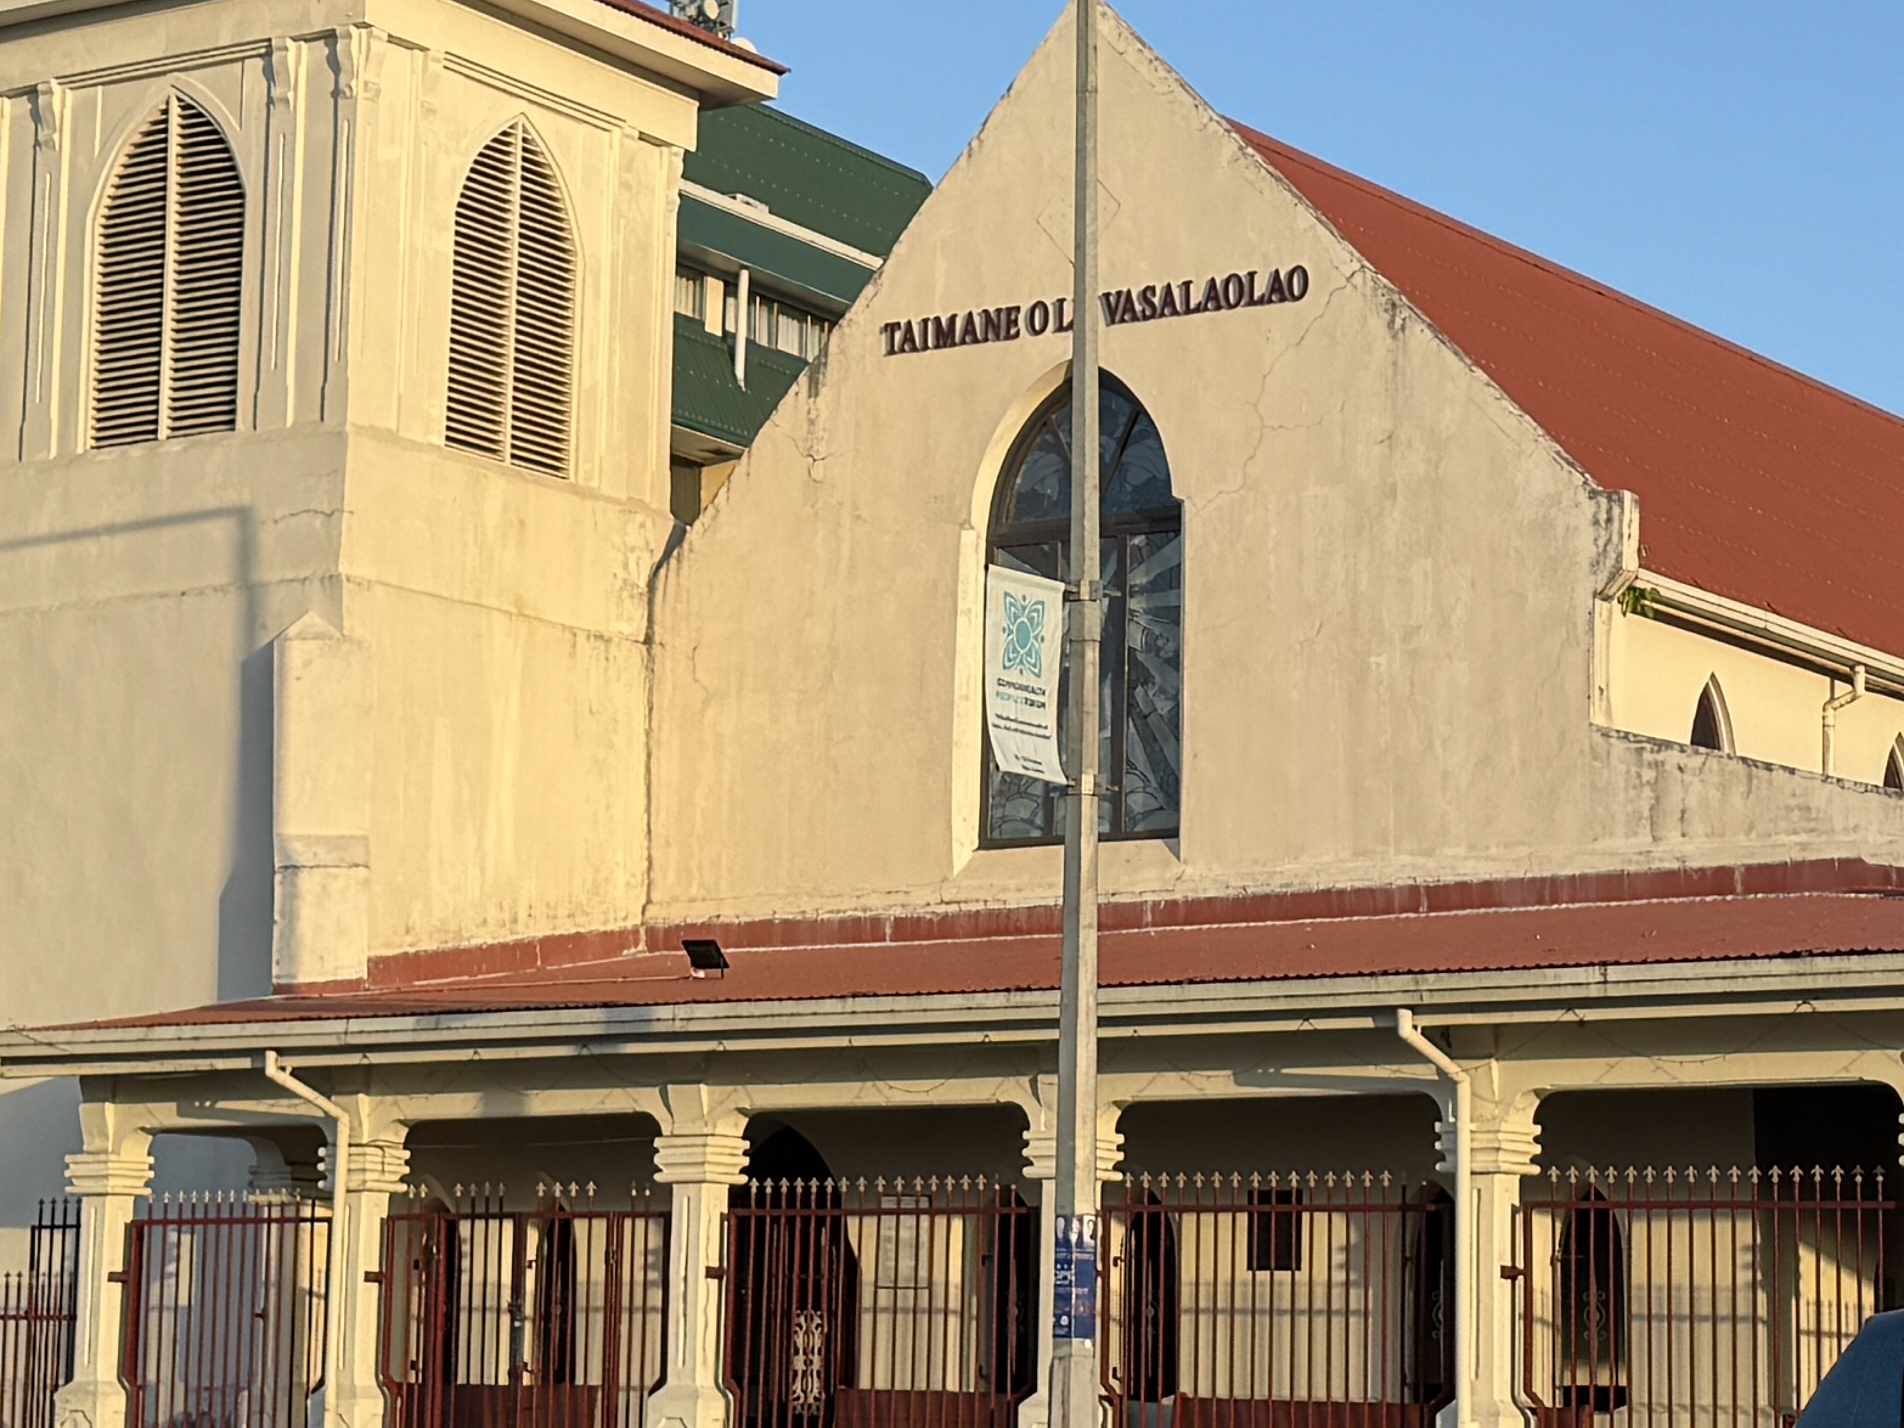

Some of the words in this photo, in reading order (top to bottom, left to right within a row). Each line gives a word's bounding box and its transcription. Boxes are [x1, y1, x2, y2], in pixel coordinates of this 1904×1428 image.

[879, 304, 1021, 358] TAIMANE
[1028, 299, 1050, 337] O
[1052, 296, 1075, 335] L
[1099, 264, 1310, 327] VASALAOLAO
